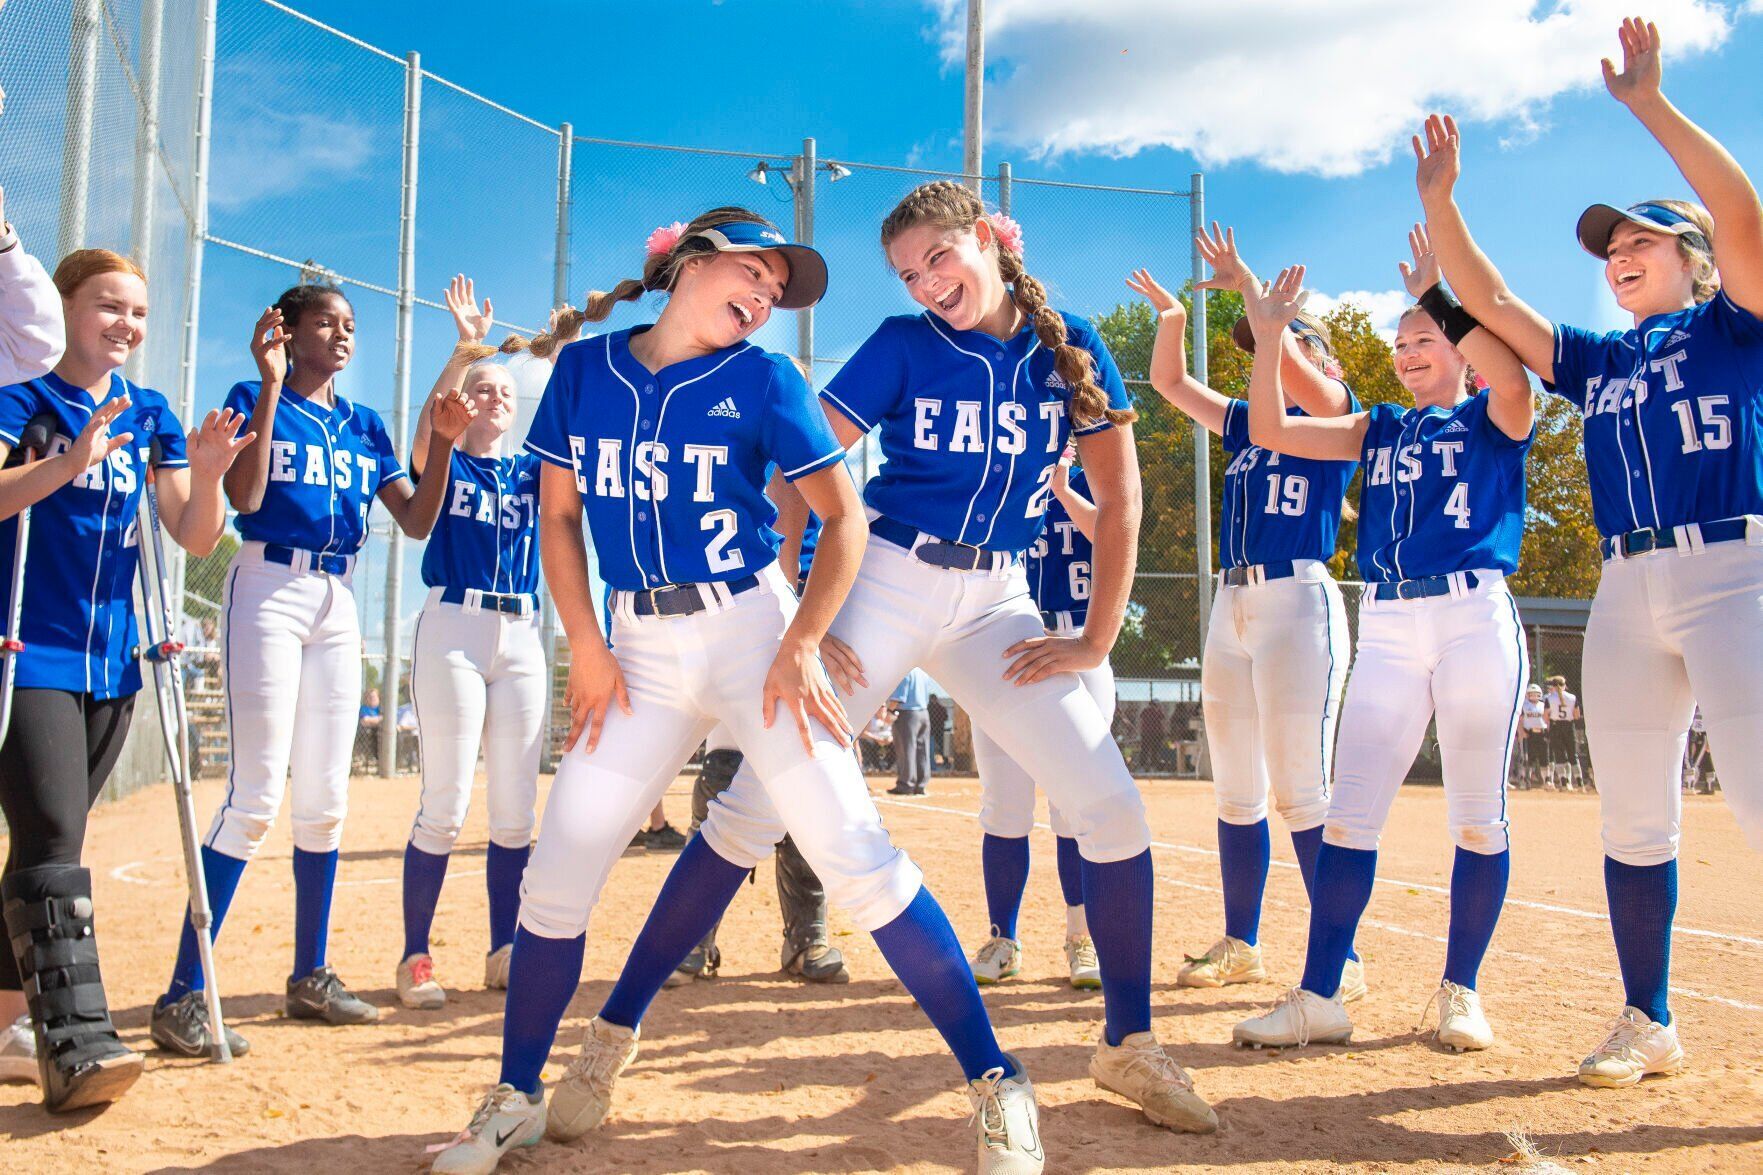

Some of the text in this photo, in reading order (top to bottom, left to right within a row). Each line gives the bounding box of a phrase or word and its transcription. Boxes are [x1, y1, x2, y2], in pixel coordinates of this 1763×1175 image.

[707, 408, 741, 419] adidas
[914, 397, 1065, 455] EAST
[1671, 395, 1732, 454] 15
[47, 432, 150, 494] AS
[270, 440, 377, 496] EAST
[568, 435, 729, 503] EAST
[1024, 463, 1057, 519] 2
[449, 479, 535, 530] EAST
[1264, 473, 1309, 517] 19
[1443, 482, 1471, 529] 4
[700, 508, 746, 575] 2
[1068, 561, 1091, 601] 6
[1558, 704, 1567, 719] 5
